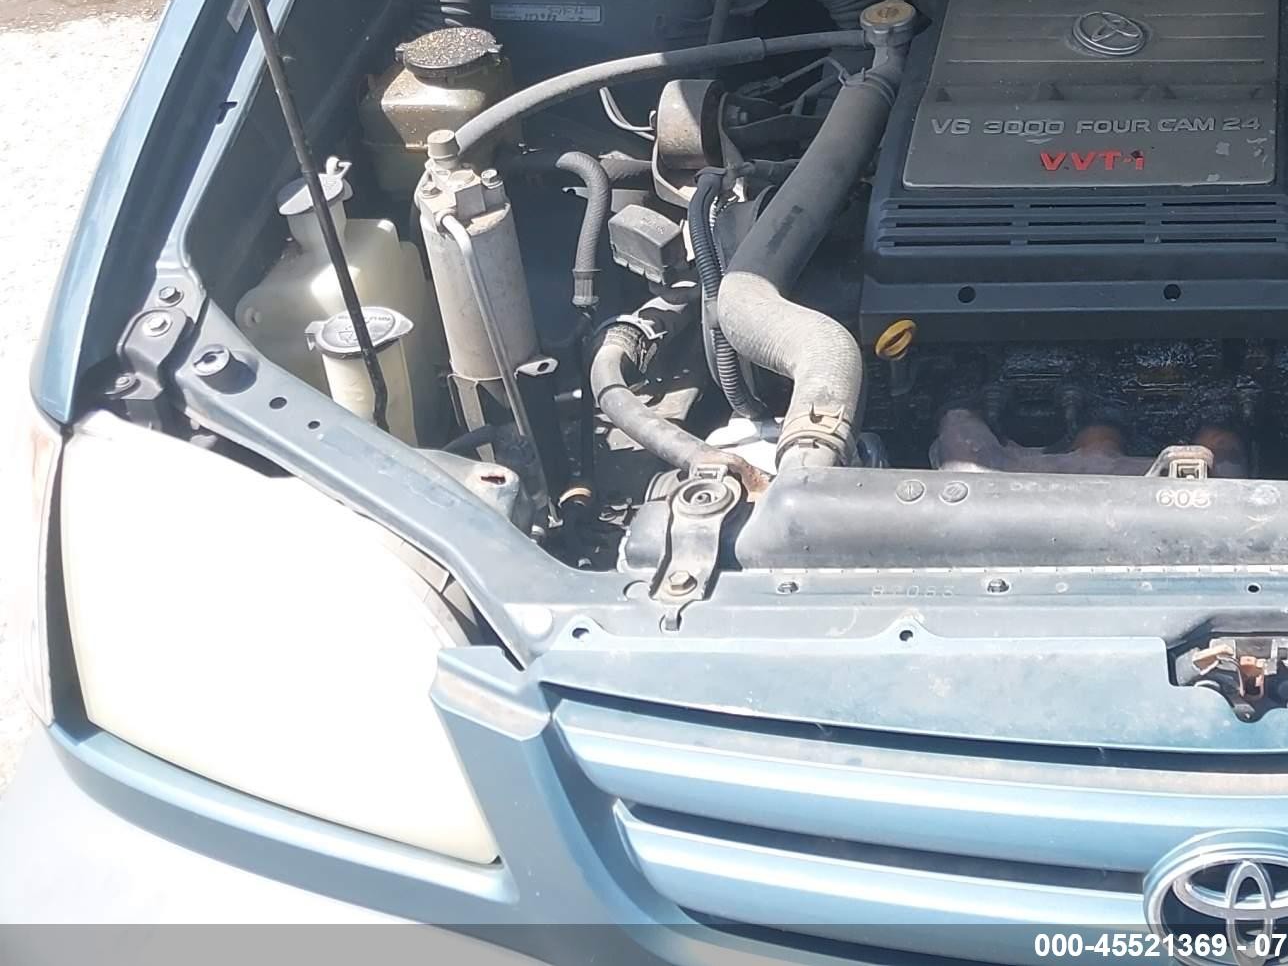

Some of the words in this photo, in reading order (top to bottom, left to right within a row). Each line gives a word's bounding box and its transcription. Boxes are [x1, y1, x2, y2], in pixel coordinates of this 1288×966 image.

[930, 119, 970, 135] V6
[983, 119, 1065, 136] 3000
[1075, 118, 1151, 134] FOUR
[1158, 117, 1215, 133] CAM
[1221, 116, 1264, 131] 24
